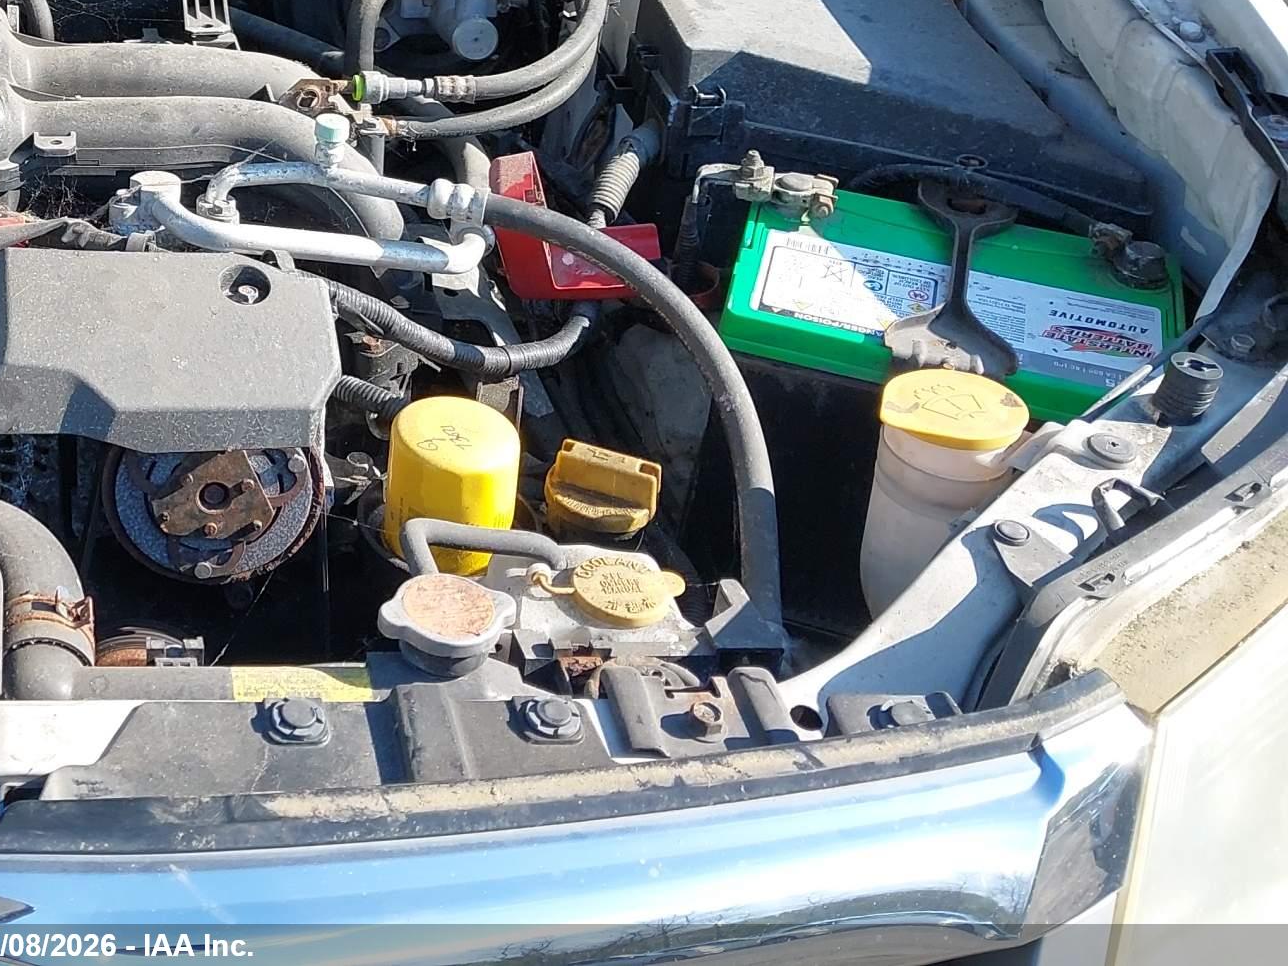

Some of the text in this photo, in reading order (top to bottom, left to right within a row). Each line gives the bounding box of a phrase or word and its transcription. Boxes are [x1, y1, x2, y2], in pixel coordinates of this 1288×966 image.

[793, 312, 884, 336] ANGER/POISON
[1049, 309, 1149, 334] AUTOMOTIVE
[1042, 329, 1157, 359] INTERSTATE
[1049, 325, 1153, 352] BATTERIES
[575, 555, 652, 579] COOLANT
